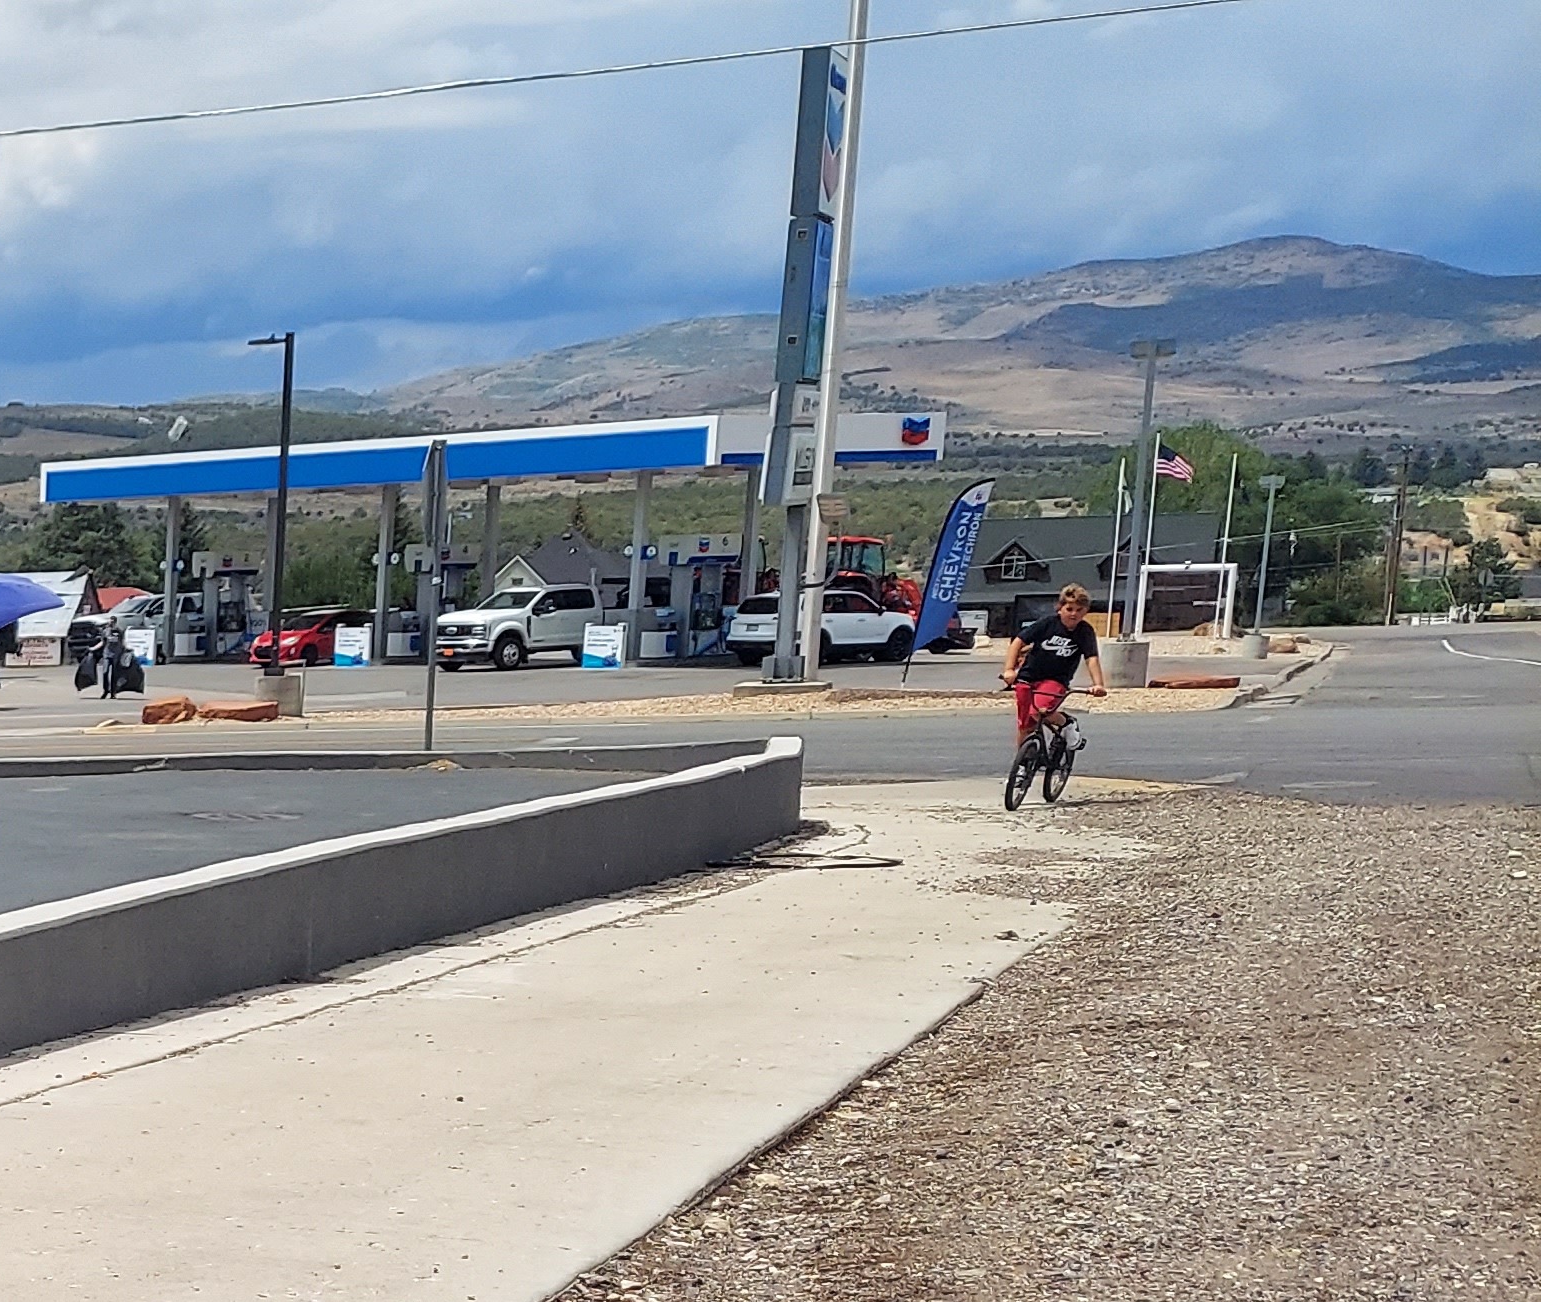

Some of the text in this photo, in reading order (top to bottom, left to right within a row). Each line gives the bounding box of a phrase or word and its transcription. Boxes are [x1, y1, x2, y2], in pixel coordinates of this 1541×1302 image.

[939, 511, 973, 602] CHEVRON
[951, 512, 983, 603] WITH TECHRON
